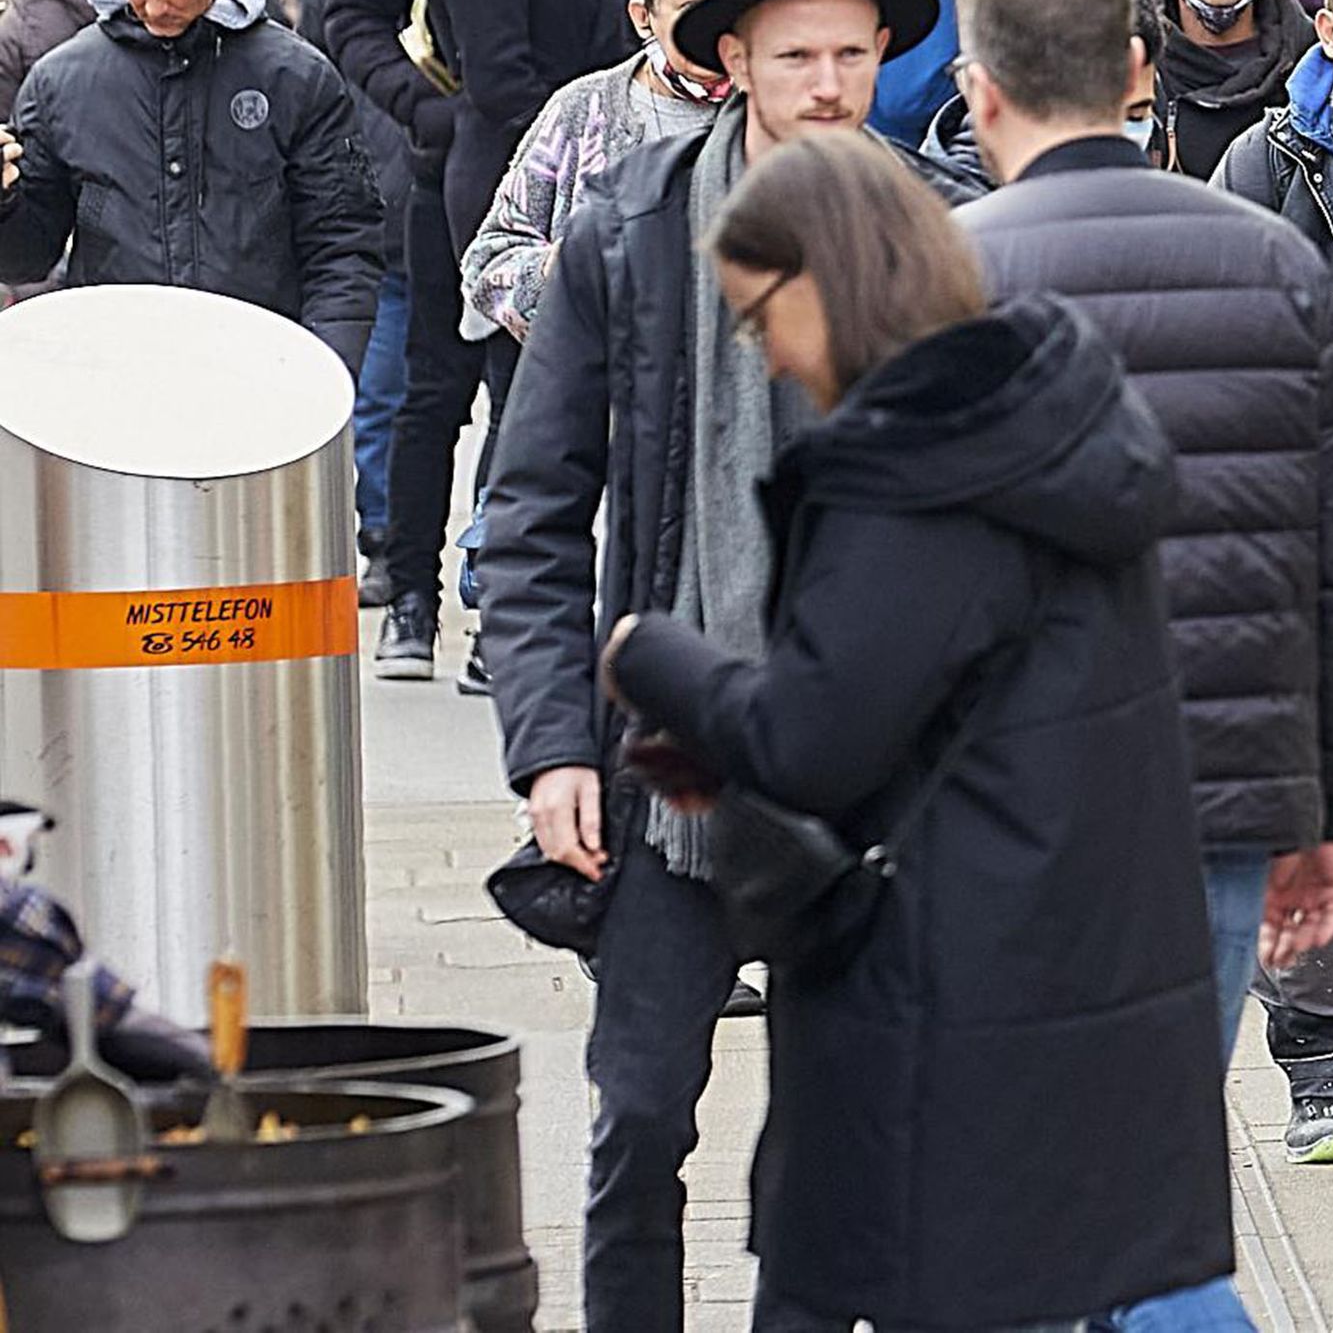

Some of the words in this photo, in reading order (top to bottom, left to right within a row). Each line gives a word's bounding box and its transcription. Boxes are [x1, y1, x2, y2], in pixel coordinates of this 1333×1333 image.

[126, 597, 273, 625] MISTTELEFON
[181, 630, 221, 652] 546
[227, 627, 256, 650] 48
